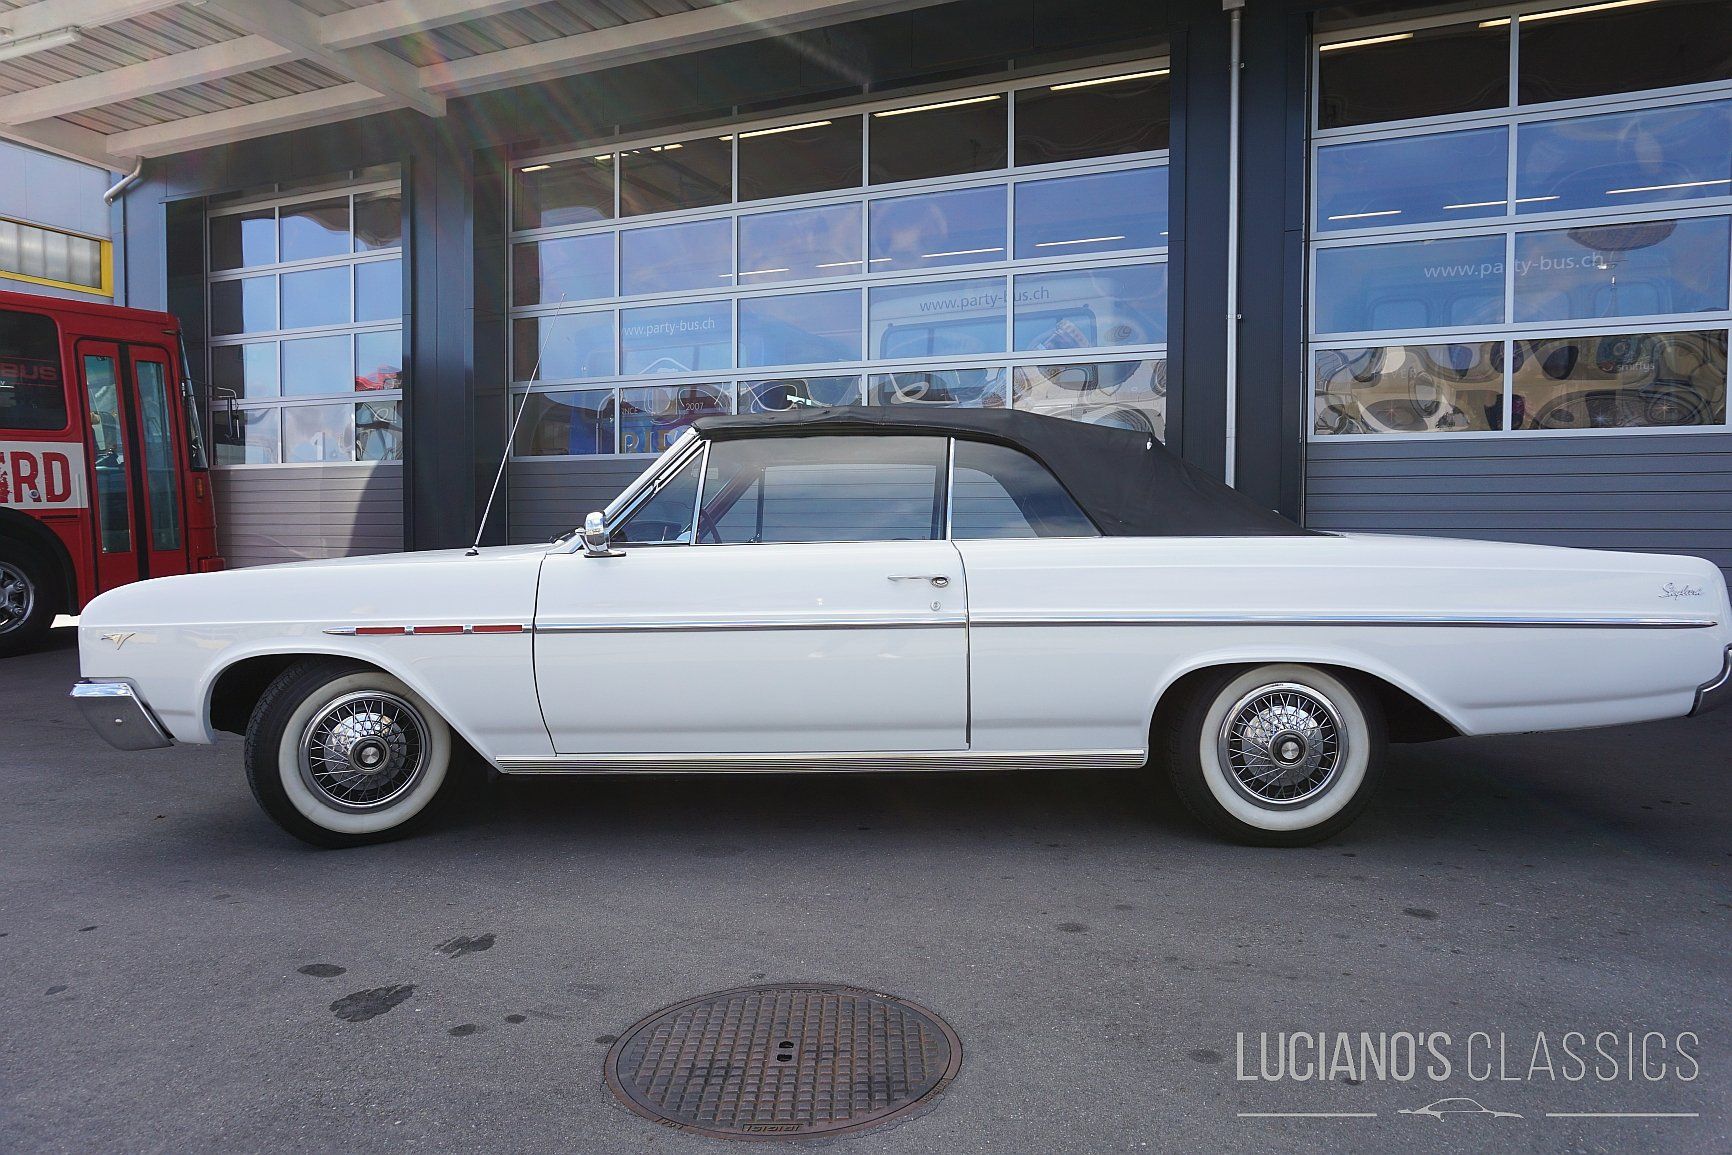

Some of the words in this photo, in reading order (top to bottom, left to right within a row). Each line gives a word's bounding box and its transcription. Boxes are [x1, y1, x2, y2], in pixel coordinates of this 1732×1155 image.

[1424, 252, 1605, 278] www.paty-bus.ch
[623, 317, 715, 336] ww.party-bus.ch
[685, 402, 704, 411] 2007
